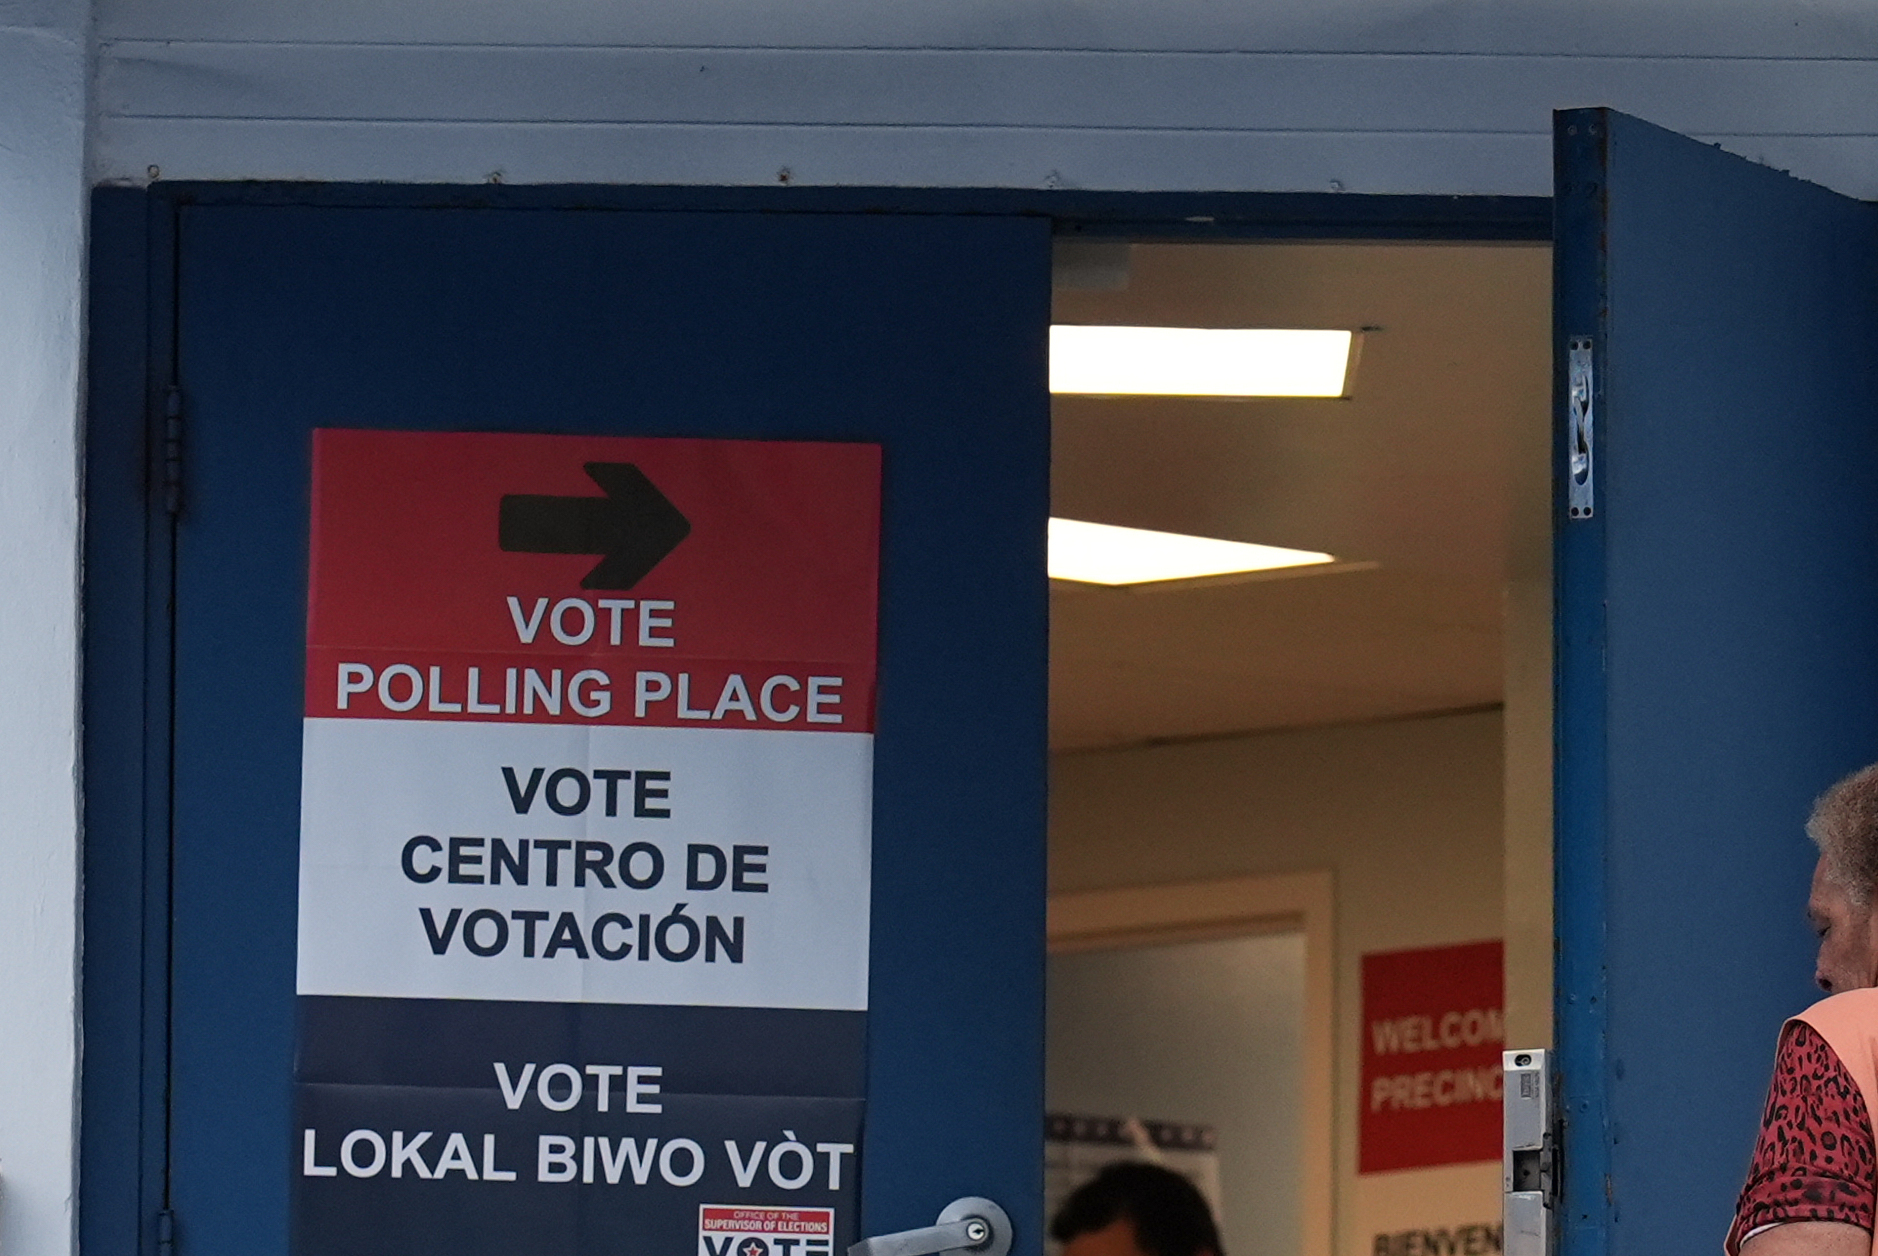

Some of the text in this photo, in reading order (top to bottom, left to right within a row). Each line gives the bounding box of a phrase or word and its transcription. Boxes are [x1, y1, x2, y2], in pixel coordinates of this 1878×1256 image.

[506, 596, 675, 648] VOTE
[335, 662, 843, 724] POLLING PLACE
[501, 766, 672, 819] VOTE
[401, 835, 769, 894] CENTRO DE
[418, 902, 745, 964] VOTACIÓN
[493, 1062, 663, 1114] VOTE
[303, 1128, 854, 1191] LOKAL BIWO VÒT
[704, 1219, 828, 1232] SUPERVISOR OF ELECTIONS
